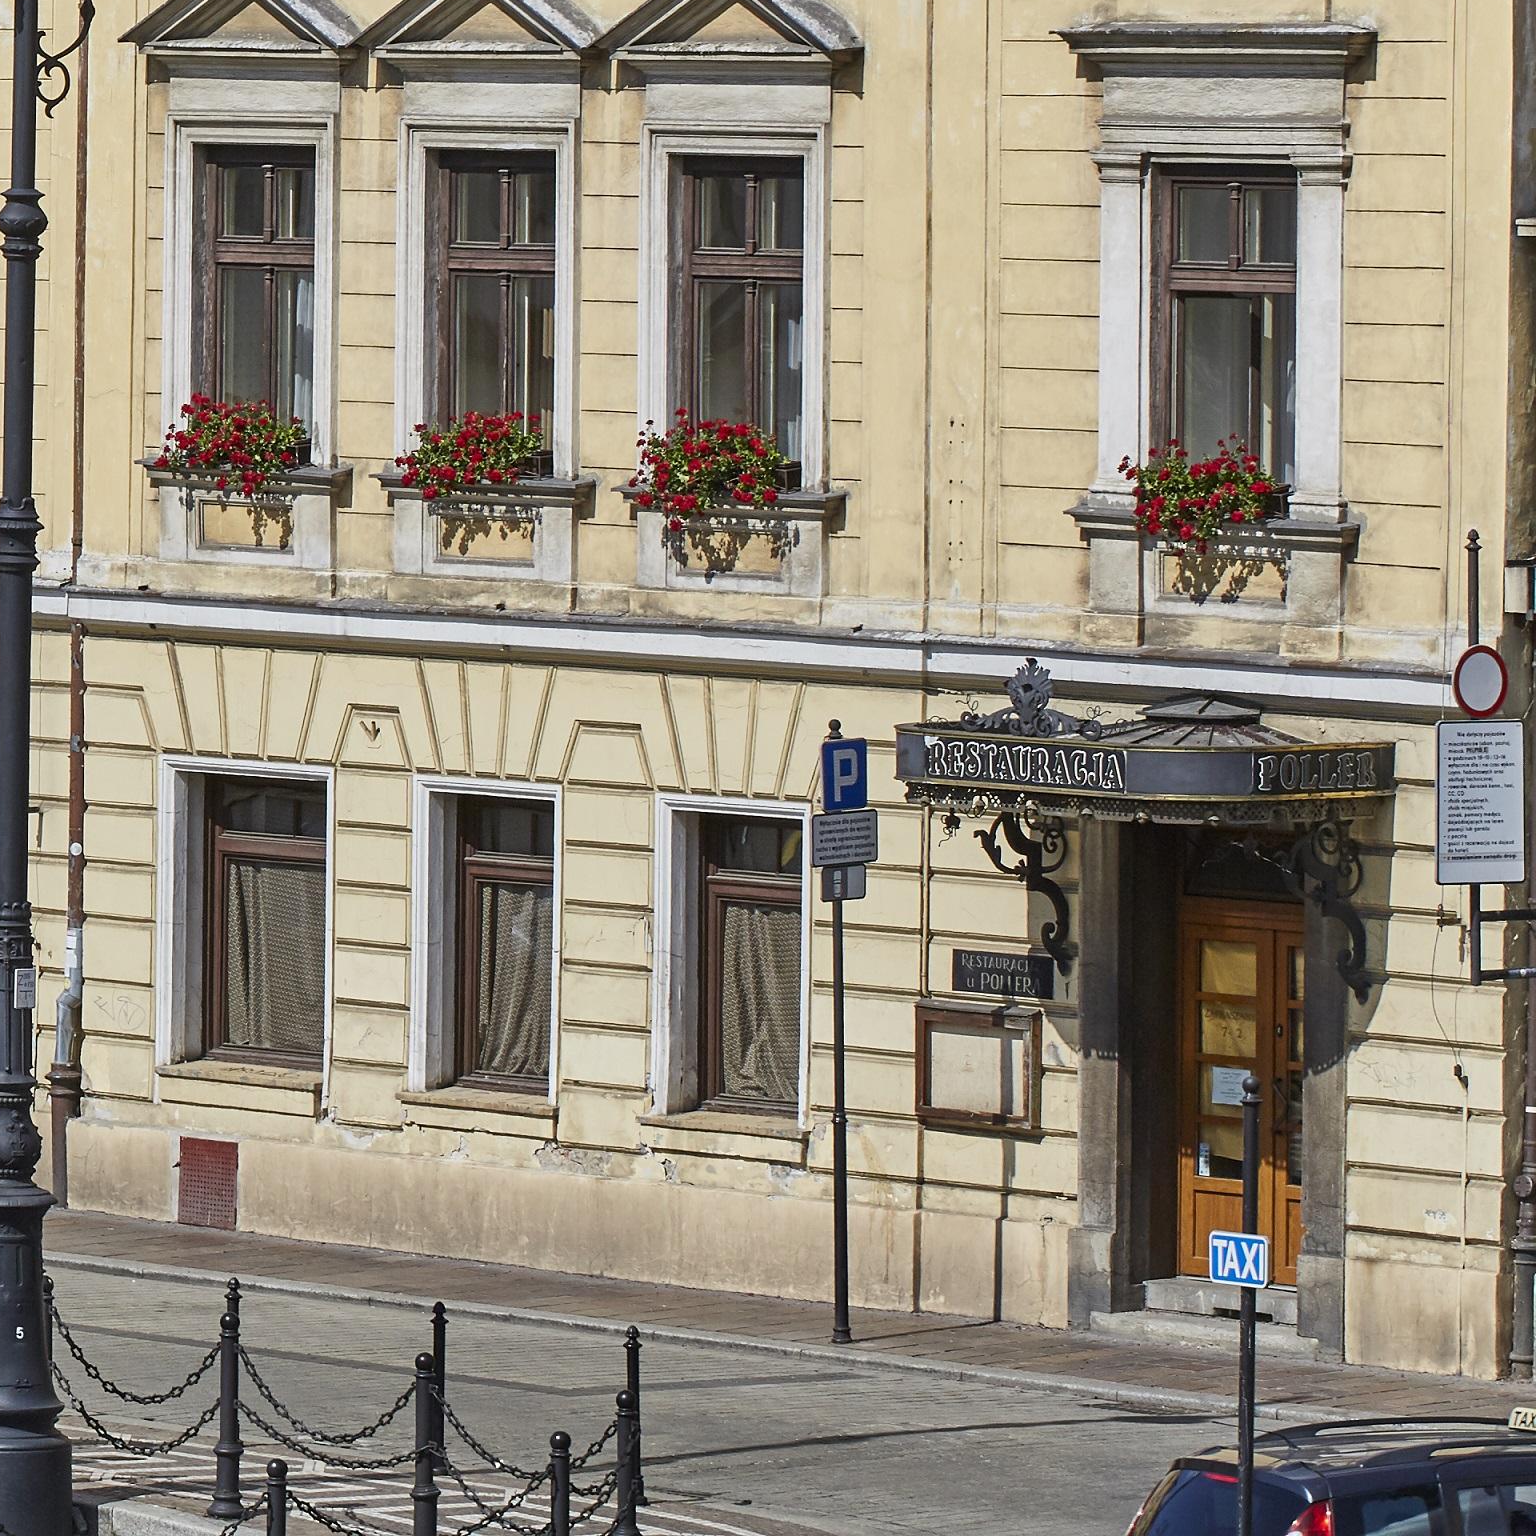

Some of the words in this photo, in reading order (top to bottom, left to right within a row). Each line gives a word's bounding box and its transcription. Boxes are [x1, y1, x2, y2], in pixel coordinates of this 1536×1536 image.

[833, 748, 858, 802] P
[928, 740, 1126, 789] RESTAURACJA
[1258, 751, 1377, 791] POLLER
[962, 953, 1037, 973] RESTAURACJ
[967, 978, 974, 988] u
[1212, 1238, 1264, 1281] TAXI
[16, 1326, 24, 1340] 5
[1515, 1412, 1536, 1428] TAX
